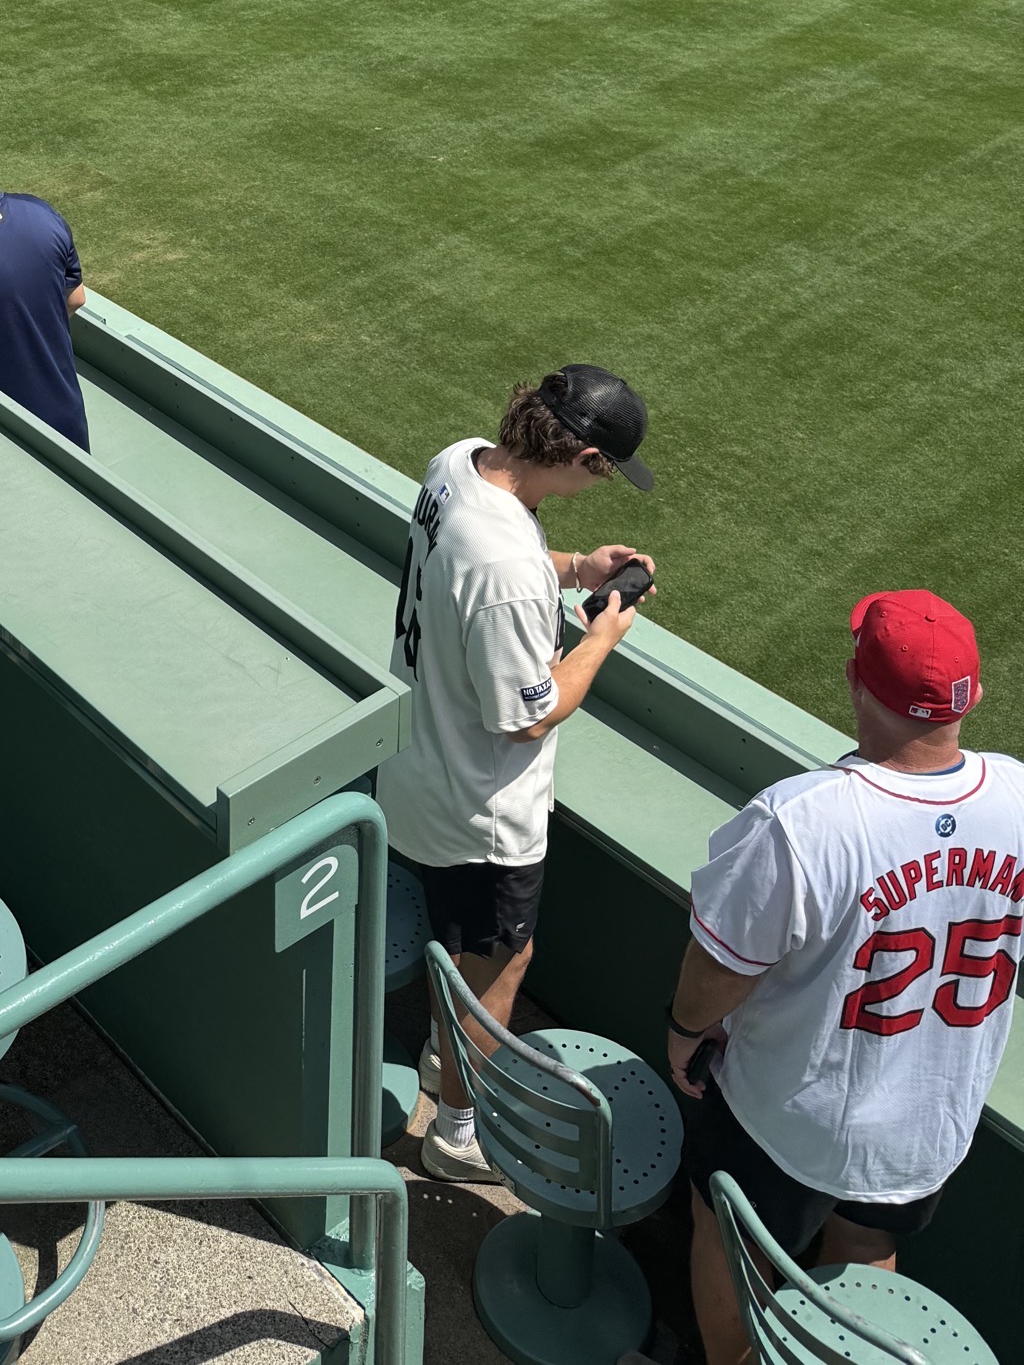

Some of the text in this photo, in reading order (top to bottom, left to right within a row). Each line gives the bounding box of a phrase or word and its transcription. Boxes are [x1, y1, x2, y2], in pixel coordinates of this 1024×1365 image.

[523, 688, 535, 697] NO
[940, 818, 952, 833] DC
[300, 856, 339, 920] 2
[839, 914, 1023, 1037] 25
